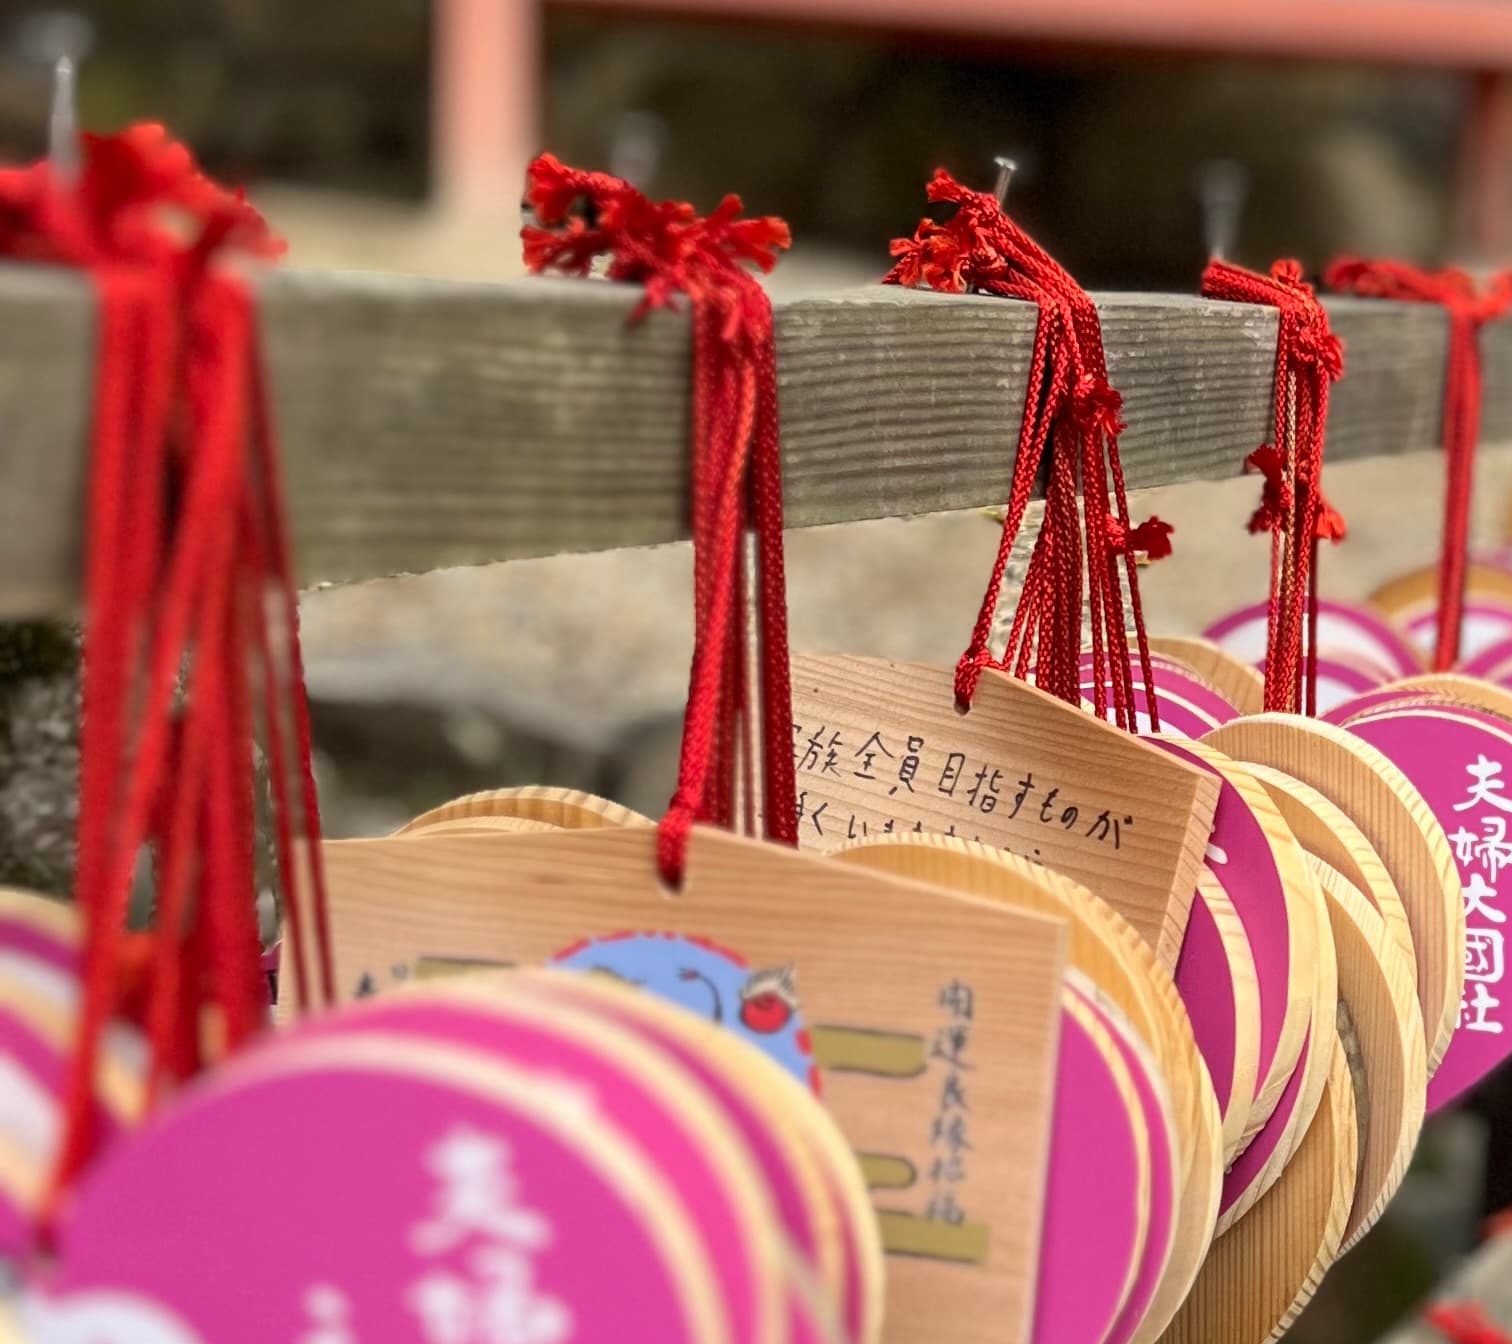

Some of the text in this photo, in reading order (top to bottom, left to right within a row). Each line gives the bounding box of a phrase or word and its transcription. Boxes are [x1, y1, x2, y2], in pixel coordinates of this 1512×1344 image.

[792, 722, 1133, 848] 族全員目指すものが
